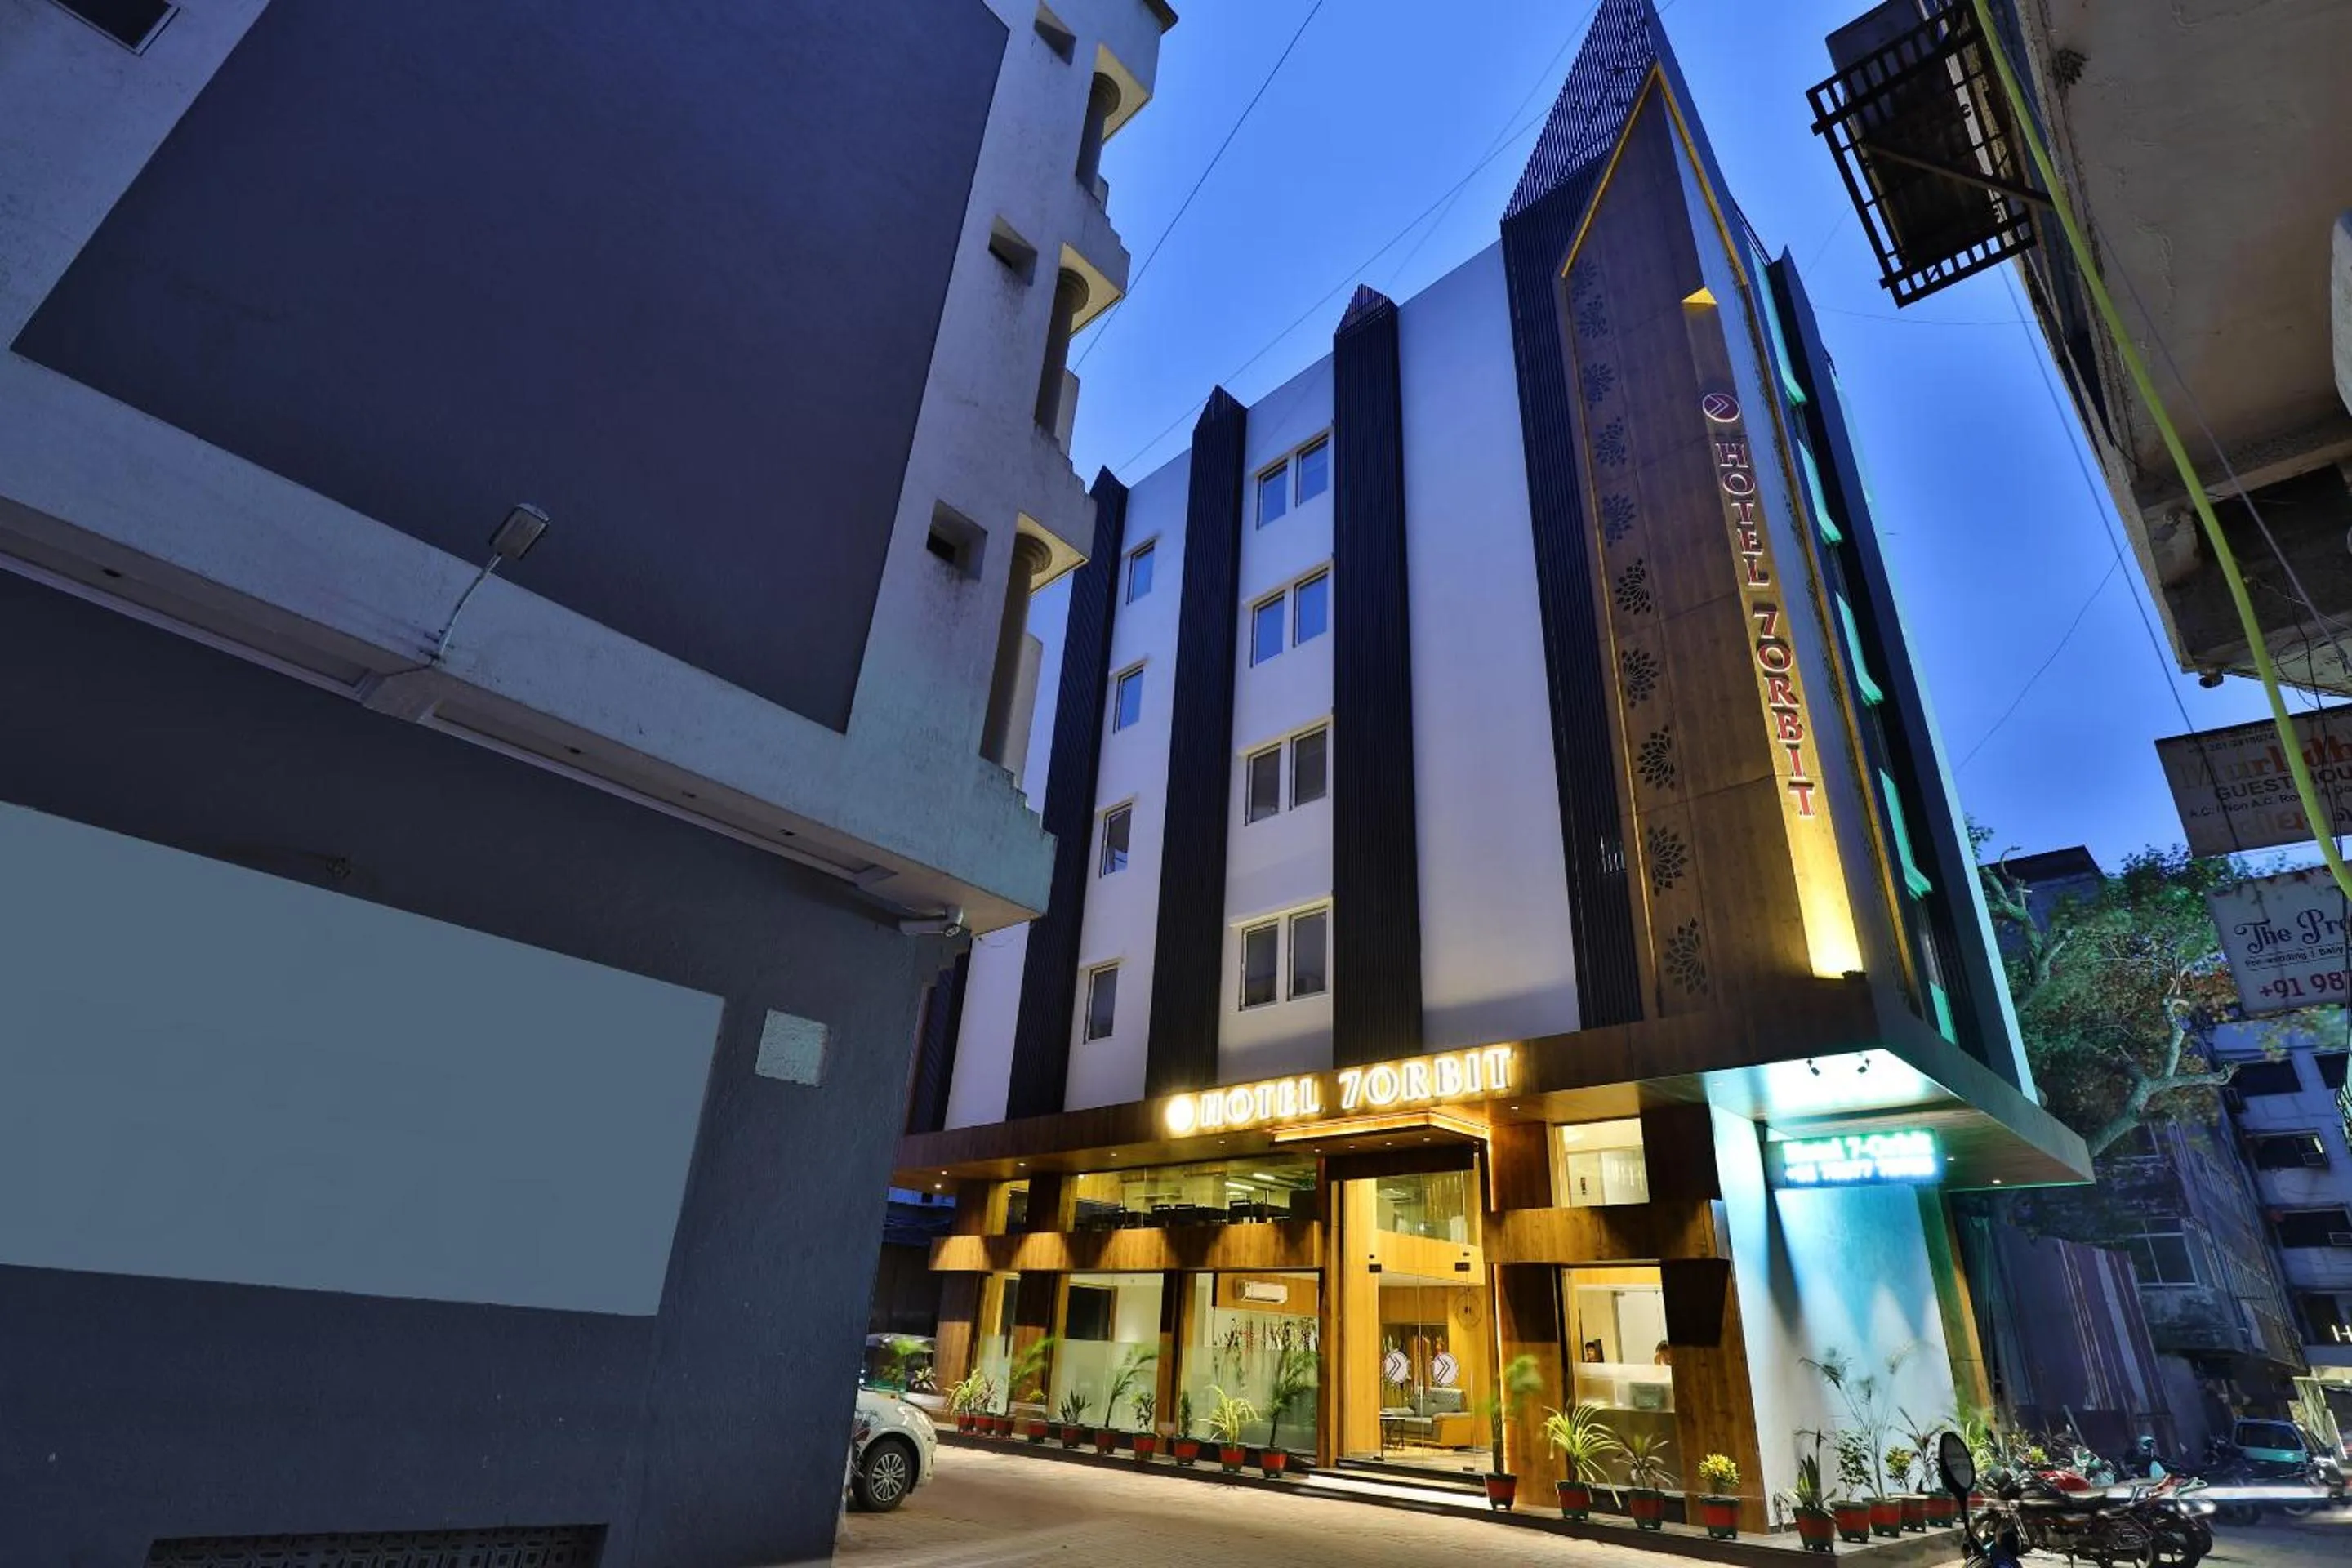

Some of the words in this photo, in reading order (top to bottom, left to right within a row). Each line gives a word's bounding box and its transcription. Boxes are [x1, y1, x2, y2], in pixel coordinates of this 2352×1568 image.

[1715, 442, 1771, 586] HOTEL
[1753, 608, 1815, 817] 7ORBIT
[2216, 776, 2293, 802] GUEST
[2234, 919, 2292, 954] The
[2259, 977, 2307, 998] +91
[2309, 969, 2348, 994] 98
[1200, 1077, 1321, 1127] HOTEL
[1338, 1045, 1514, 1110] 7ORBIT
